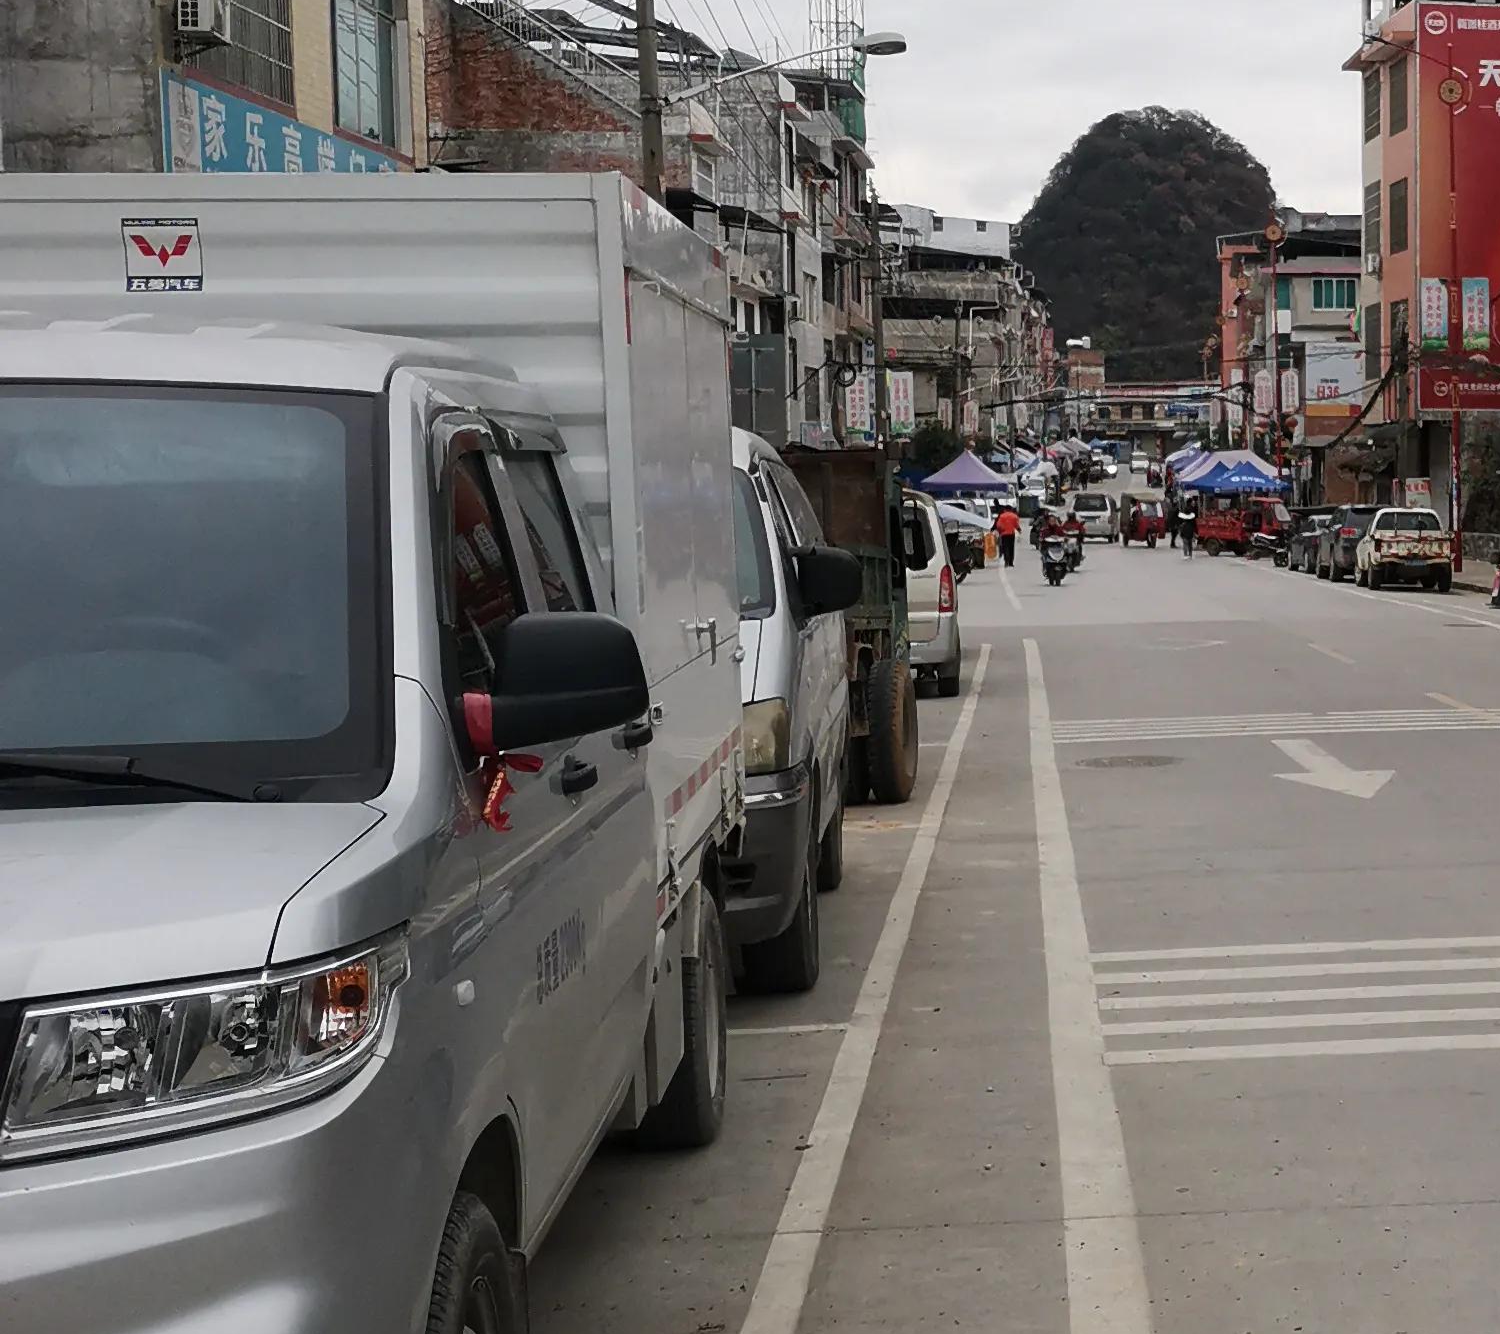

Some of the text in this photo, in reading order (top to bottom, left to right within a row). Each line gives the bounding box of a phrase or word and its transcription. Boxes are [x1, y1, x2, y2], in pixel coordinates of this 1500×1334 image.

[200, 93, 396, 173] 家乐高端门
[130, 278, 200, 291] 五菱汽车
